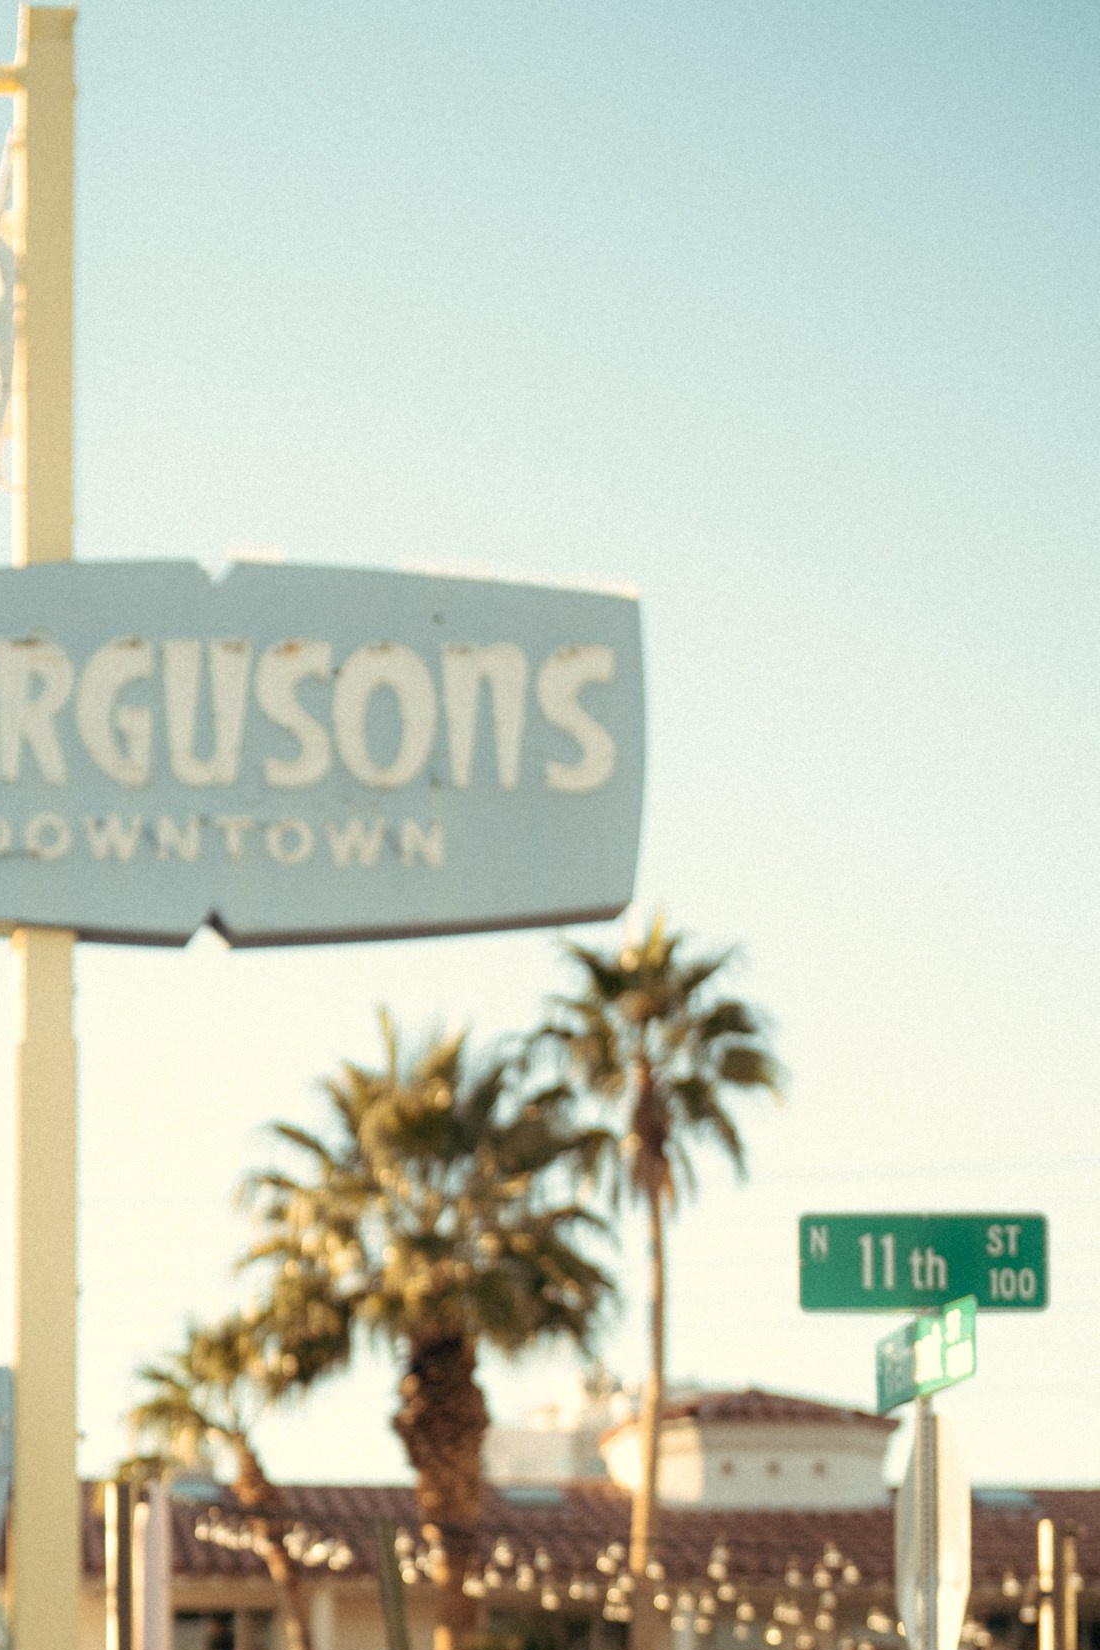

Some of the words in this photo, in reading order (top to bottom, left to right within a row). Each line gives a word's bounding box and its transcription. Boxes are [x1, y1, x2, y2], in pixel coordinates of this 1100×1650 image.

[808, 1225, 830, 1256] N
[986, 1224, 1021, 1257] ST
[989, 1267, 1037, 1300] 100
